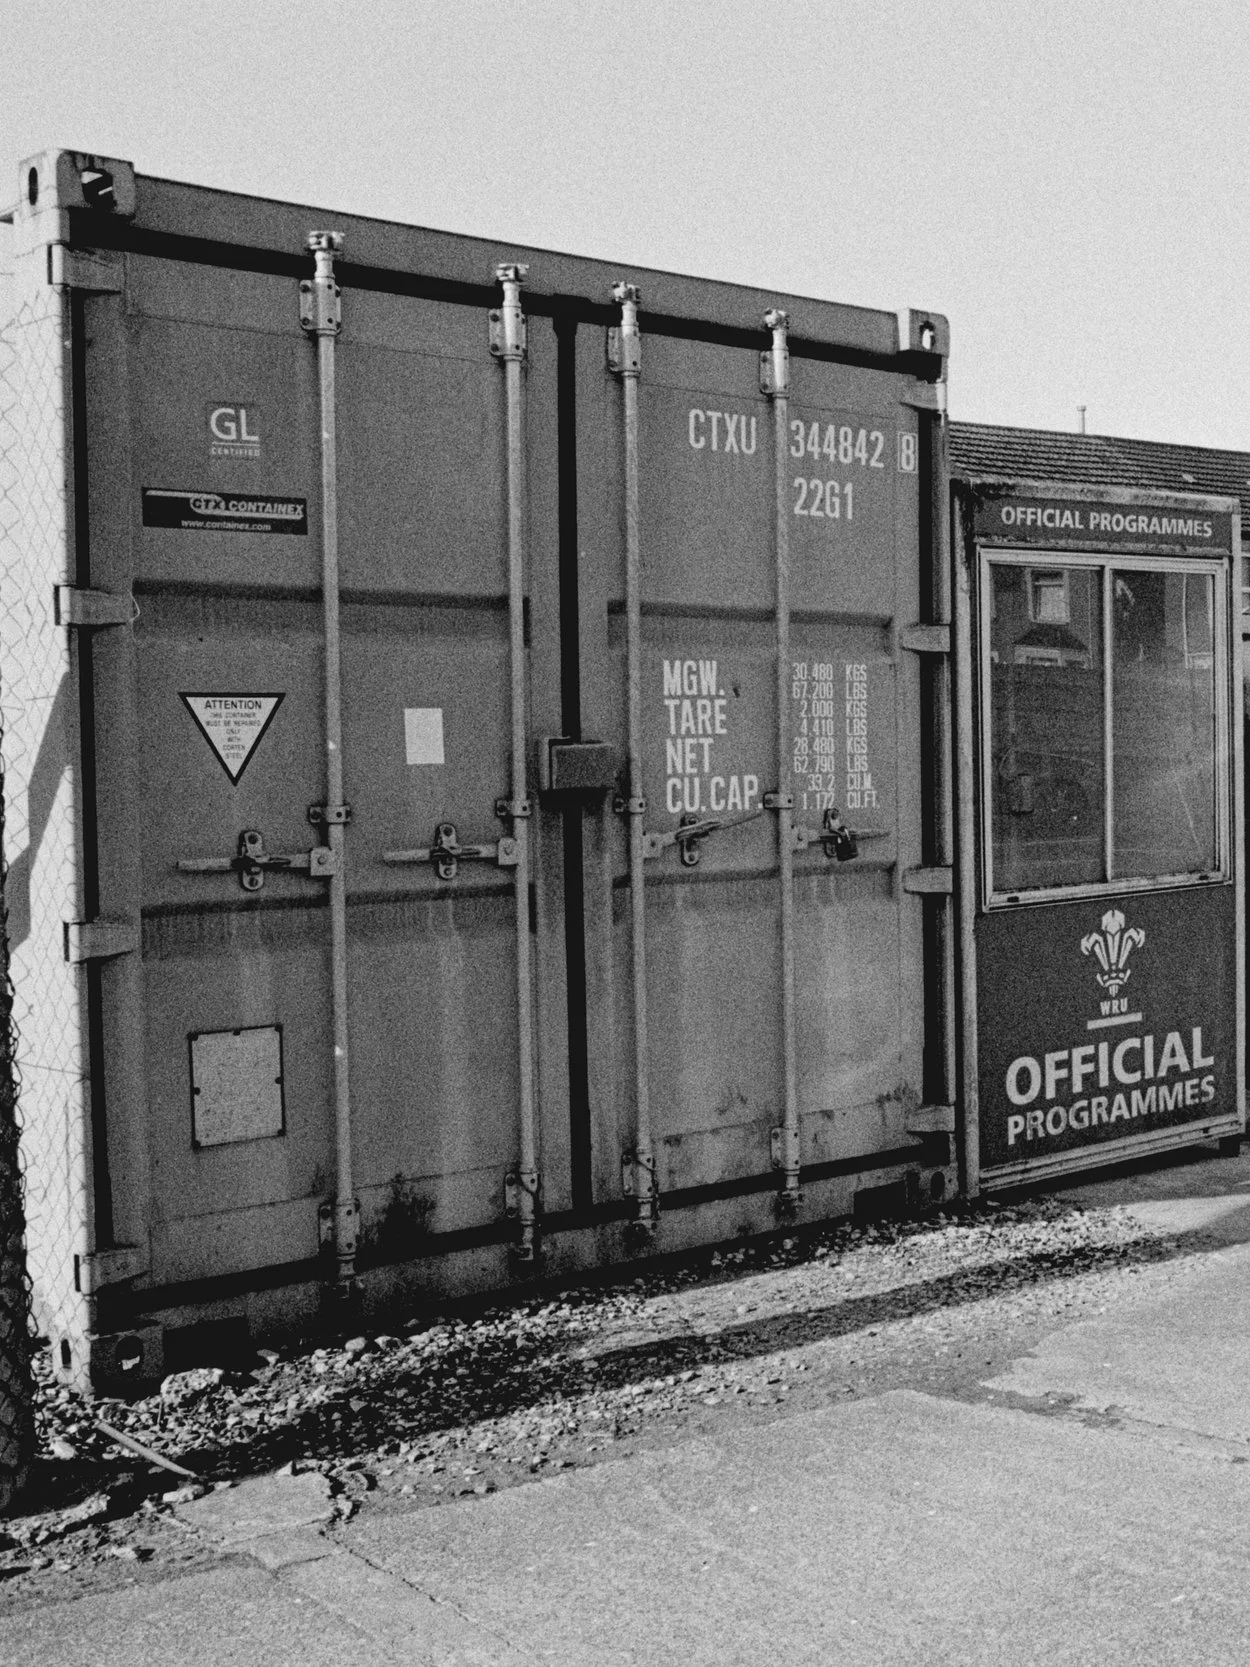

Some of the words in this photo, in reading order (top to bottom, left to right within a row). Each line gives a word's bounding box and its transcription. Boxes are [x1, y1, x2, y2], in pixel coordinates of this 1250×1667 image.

[210, 407, 260, 441] GL
[689, 408, 757, 455] CTXU
[790, 419, 885, 469] 344842
[900, 434, 916, 471] 8
[228, 500, 304, 516] CONTAINEX
[793, 477, 854, 520] 22G1
[181, 519, 272, 532] www.containex.com
[1001, 506, 1085, 530] OFFICIAL
[1089, 512, 1213, 538] PROGRAMMES
[663, 659, 726, 696] MGW.
[792, 663, 834, 681] 30.480
[845, 664, 868, 681] KGS
[792, 681, 834, 700] 67.200
[845, 682, 868, 700] LBS
[204, 699, 262, 710] ATTENTION
[800, 700, 834, 718] 2.000
[845, 701, 868, 718] KGS
[664, 699, 728, 735] TARE
[799, 718, 834, 736] 4.410
[846, 719, 868, 736] LBS
[793, 737, 835, 755] 28.480
[846, 737, 868, 754] KGS
[666, 737, 714, 775] NET
[794, 755, 835, 774] 62.790
[847, 755, 869, 773] LBS
[808, 773, 835, 792] 33.2
[666, 774, 764, 814] CU.CAP.
[803, 792, 835, 810] 1.172
[1099, 997, 1129, 1016] WRU
[1005, 1026, 1215, 1106] OFFICIAL
[1007, 1074, 1216, 1146] PROGRAMMES
